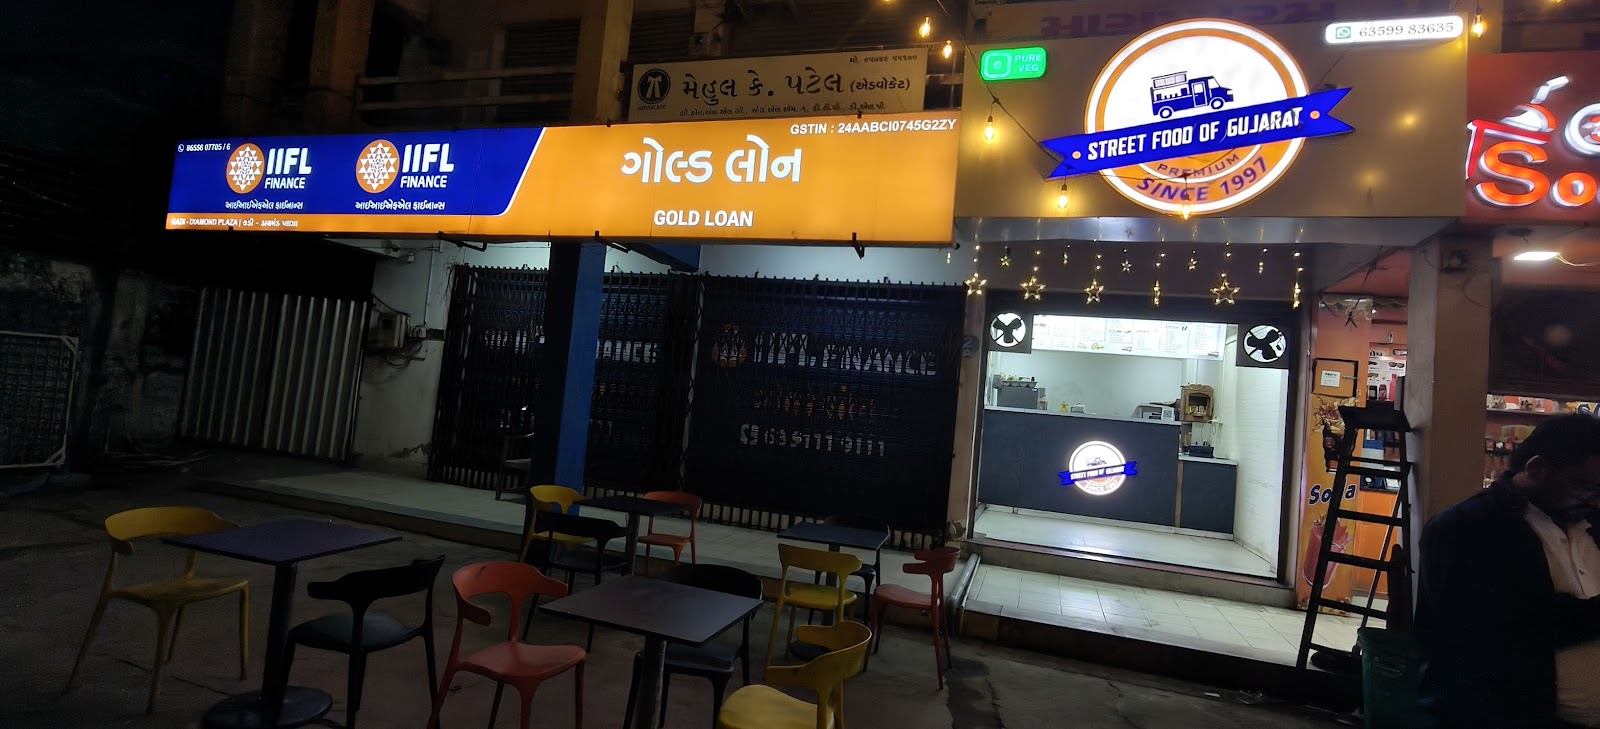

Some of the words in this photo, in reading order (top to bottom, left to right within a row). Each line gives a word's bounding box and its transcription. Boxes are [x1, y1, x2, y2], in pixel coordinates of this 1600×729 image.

[1359, 25, 1404, 37] 63599
[1408, 22, 1454, 35] 83635
[1014, 53, 1042, 63] PURE
[1018, 63, 1039, 72] VEG
[682, 70, 738, 106] મેહુલ
[747, 70, 774, 97] કે.
[785, 66, 844, 95] પટેલ
[849, 77, 911, 93] (એડવોકેટ)
[790, 123, 827, 135] GSTIN
[837, 118, 957, 134] 24AABCI0745G2ZY
[1087, 134, 1145, 161] STREET
[1151, 125, 1194, 150] FOOD
[1199, 121, 1220, 142] OF
[1226, 107, 1303, 137] GUJARAT
[266, 147, 313, 175] IIFL
[401, 143, 455, 173] IIFL
[620, 136, 714, 183] ગોલ્ડ
[725, 134, 802, 183] લોન
[1157, 153, 1240, 177] PREMIUM
[264, 177, 306, 189] FINANCE
[400, 175, 448, 188] FINANCE
[1136, 177, 1210, 202] SINCE
[1219, 156, 1267, 195] 1997
[1475, 141, 1600, 207] So
[189, 218, 217, 226] DIAMOND
[217, 218, 238, 227] PLAZA
[653, 209, 700, 227] GOLD
[704, 209, 754, 227] LOAN
[1308, 476, 1357, 505] Soa
